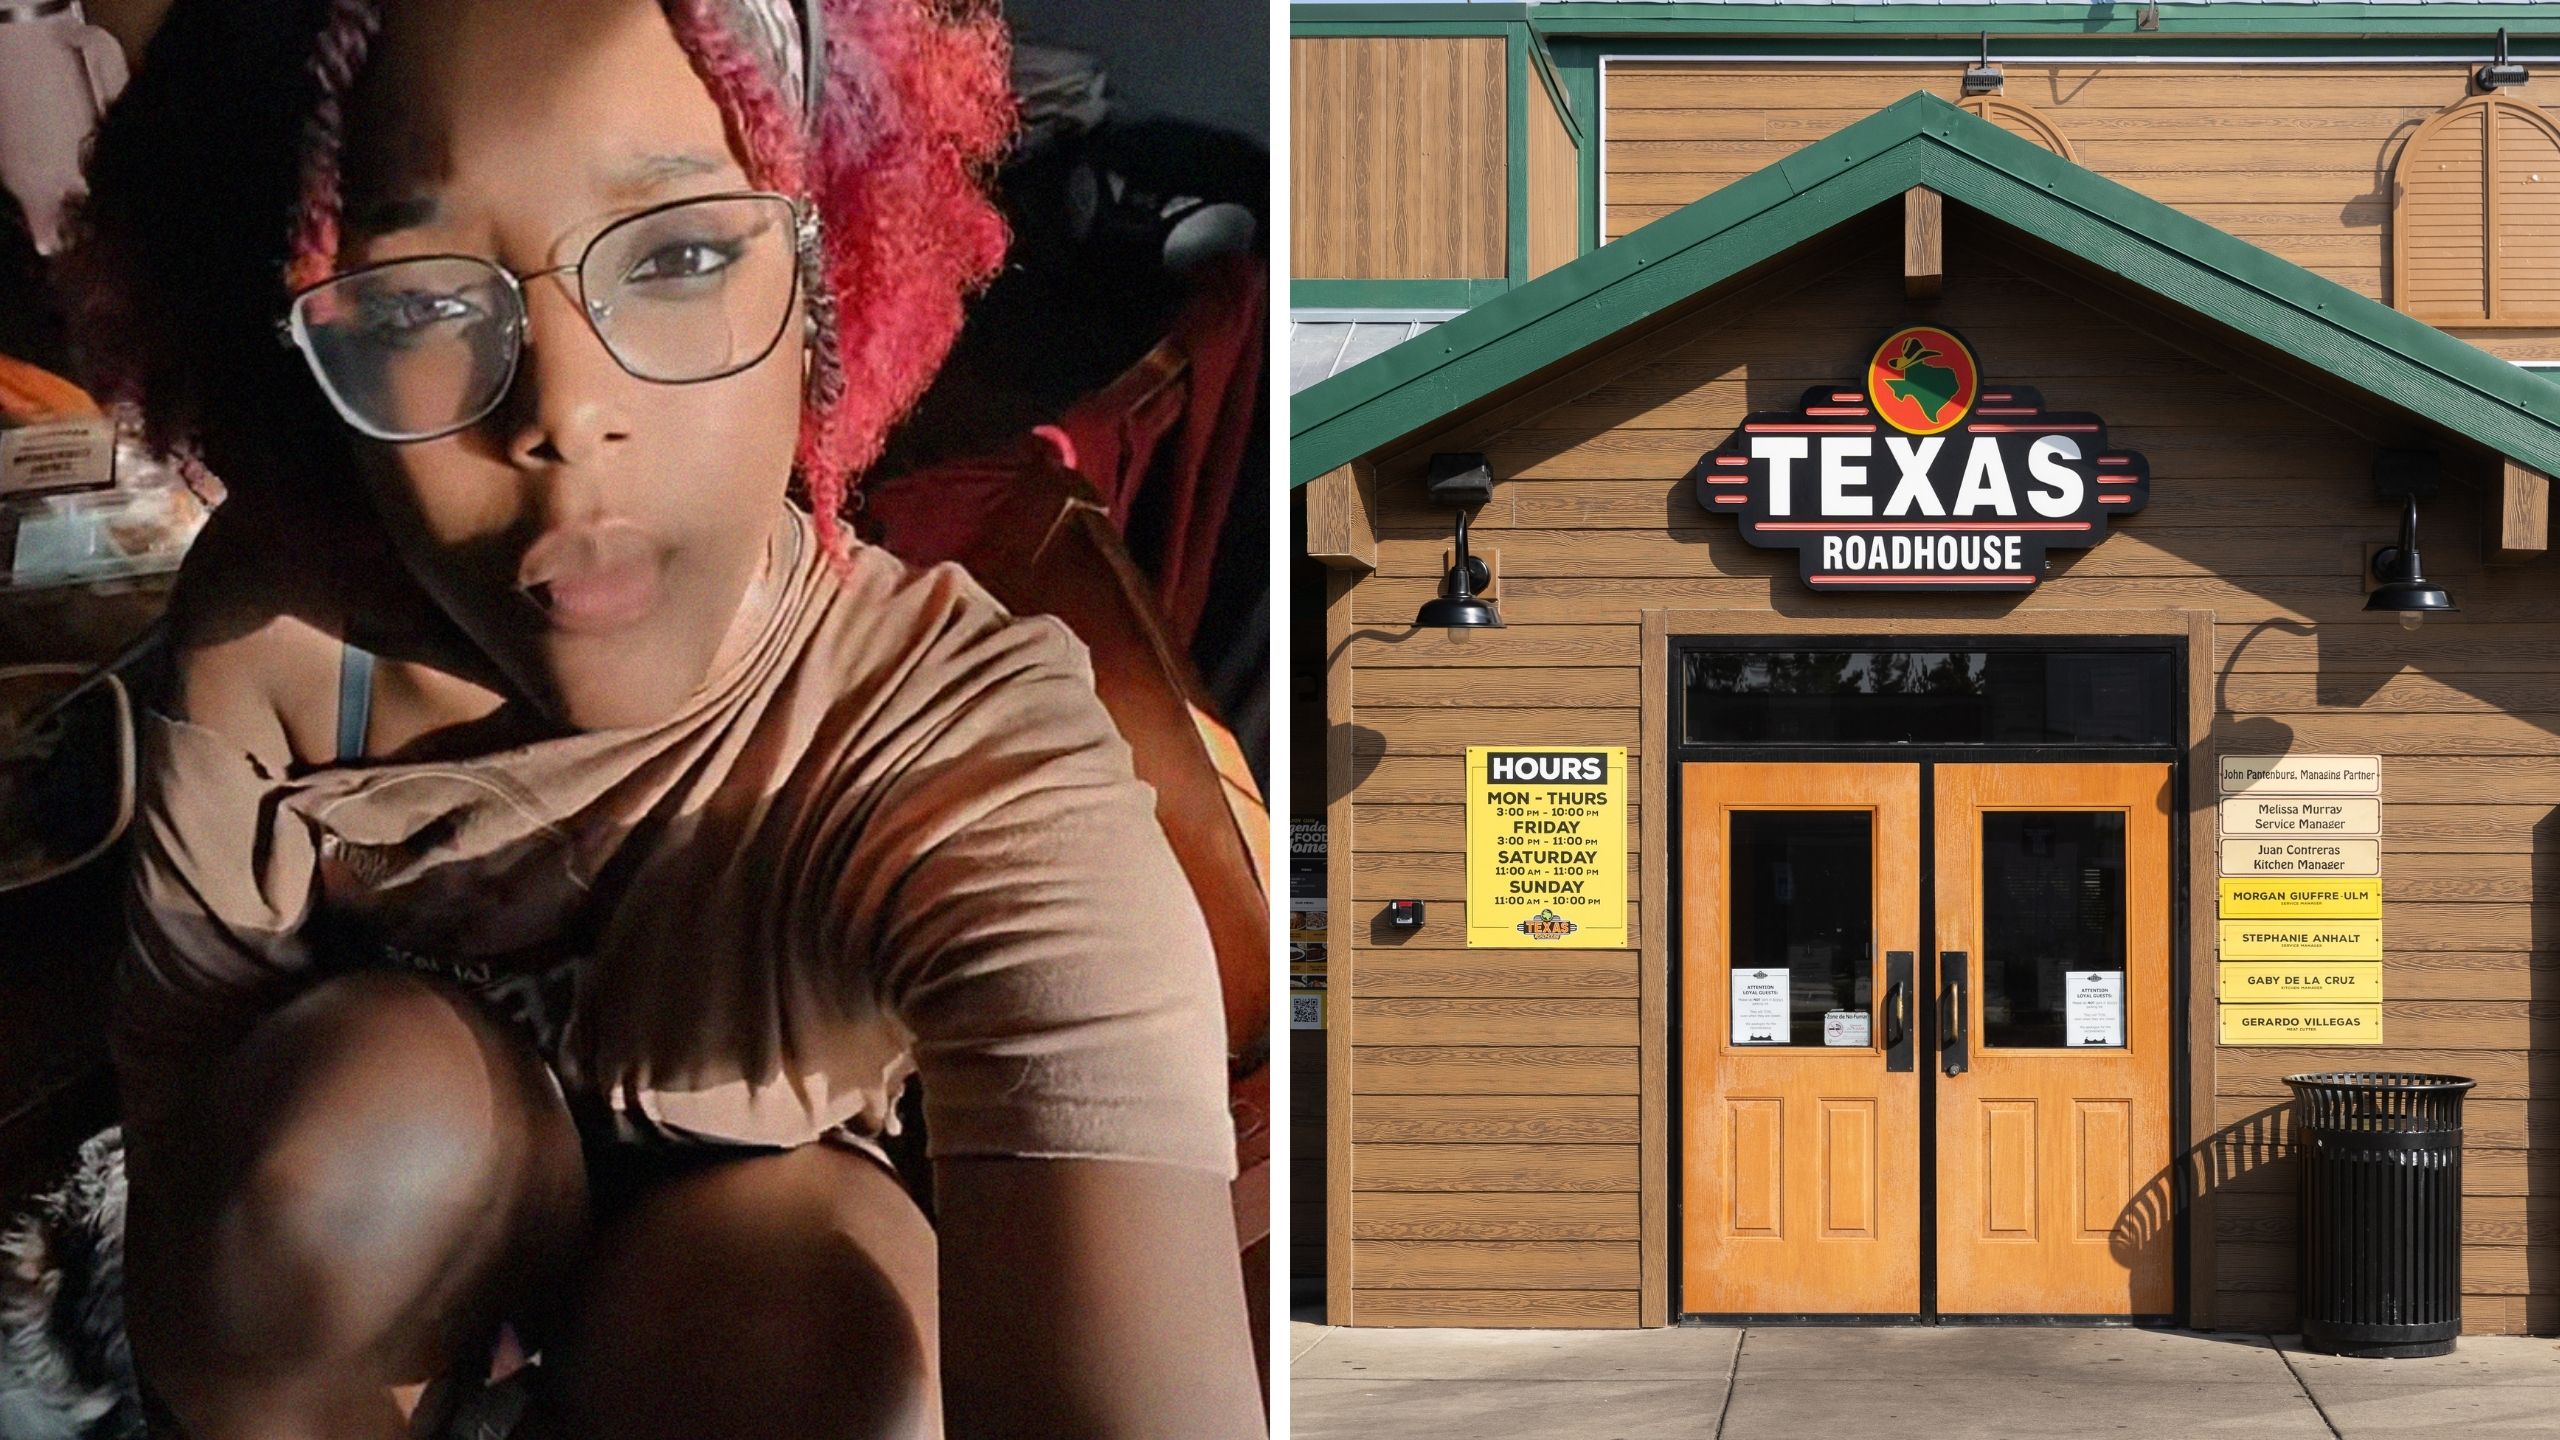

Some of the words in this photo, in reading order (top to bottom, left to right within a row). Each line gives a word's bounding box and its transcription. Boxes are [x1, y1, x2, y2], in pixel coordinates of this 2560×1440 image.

[1750, 435, 2084, 518] TEXAS
[1823, 535, 2021, 570] ROADHOUSE
[1493, 757, 1602, 781] HOURS
[2224, 769, 2243, 779] John
[2301, 770, 2340, 779] Managing
[2344, 770, 2375, 779] Partner
[1488, 792, 1529, 805] MON
[1547, 792, 1607, 805] THURS
[1497, 808, 1524, 816] 3:00
[1552, 808, 1584, 816] 10:00
[2259, 805, 2298, 814] Melissa
[2303, 805, 2342, 814] Murray
[1514, 821, 1580, 833] FRIDAY
[2256, 819, 2295, 829] Service
[2299, 819, 2345, 829] Manager
[1498, 837, 1523, 845] 3:00
[1553, 837, 1582, 845] 11:00
[2258, 845, 2282, 854] Juan
[2287, 845, 2340, 855] Contreras
[1499, 851, 1597, 864] SATURDAY
[2254, 860, 2293, 869] Kitchen
[2298, 860, 2345, 869] Manager
[1496, 867, 1525, 875] 11:00
[1554, 867, 1583, 875] 11:00
[1510, 881, 1584, 893] SUNDAY
[1495, 897, 1524, 905] 11:00
[1553, 896, 1585, 905] 10:00
[2234, 892, 2285, 900] MORGAN
[1526, 922, 1569, 933] TEXAS
[2243, 934, 2307, 942] STEPHANIE
[2242, 1018, 2299, 1026] GERARDO
[2304, 1018, 2360, 1026] VILLEGAS
